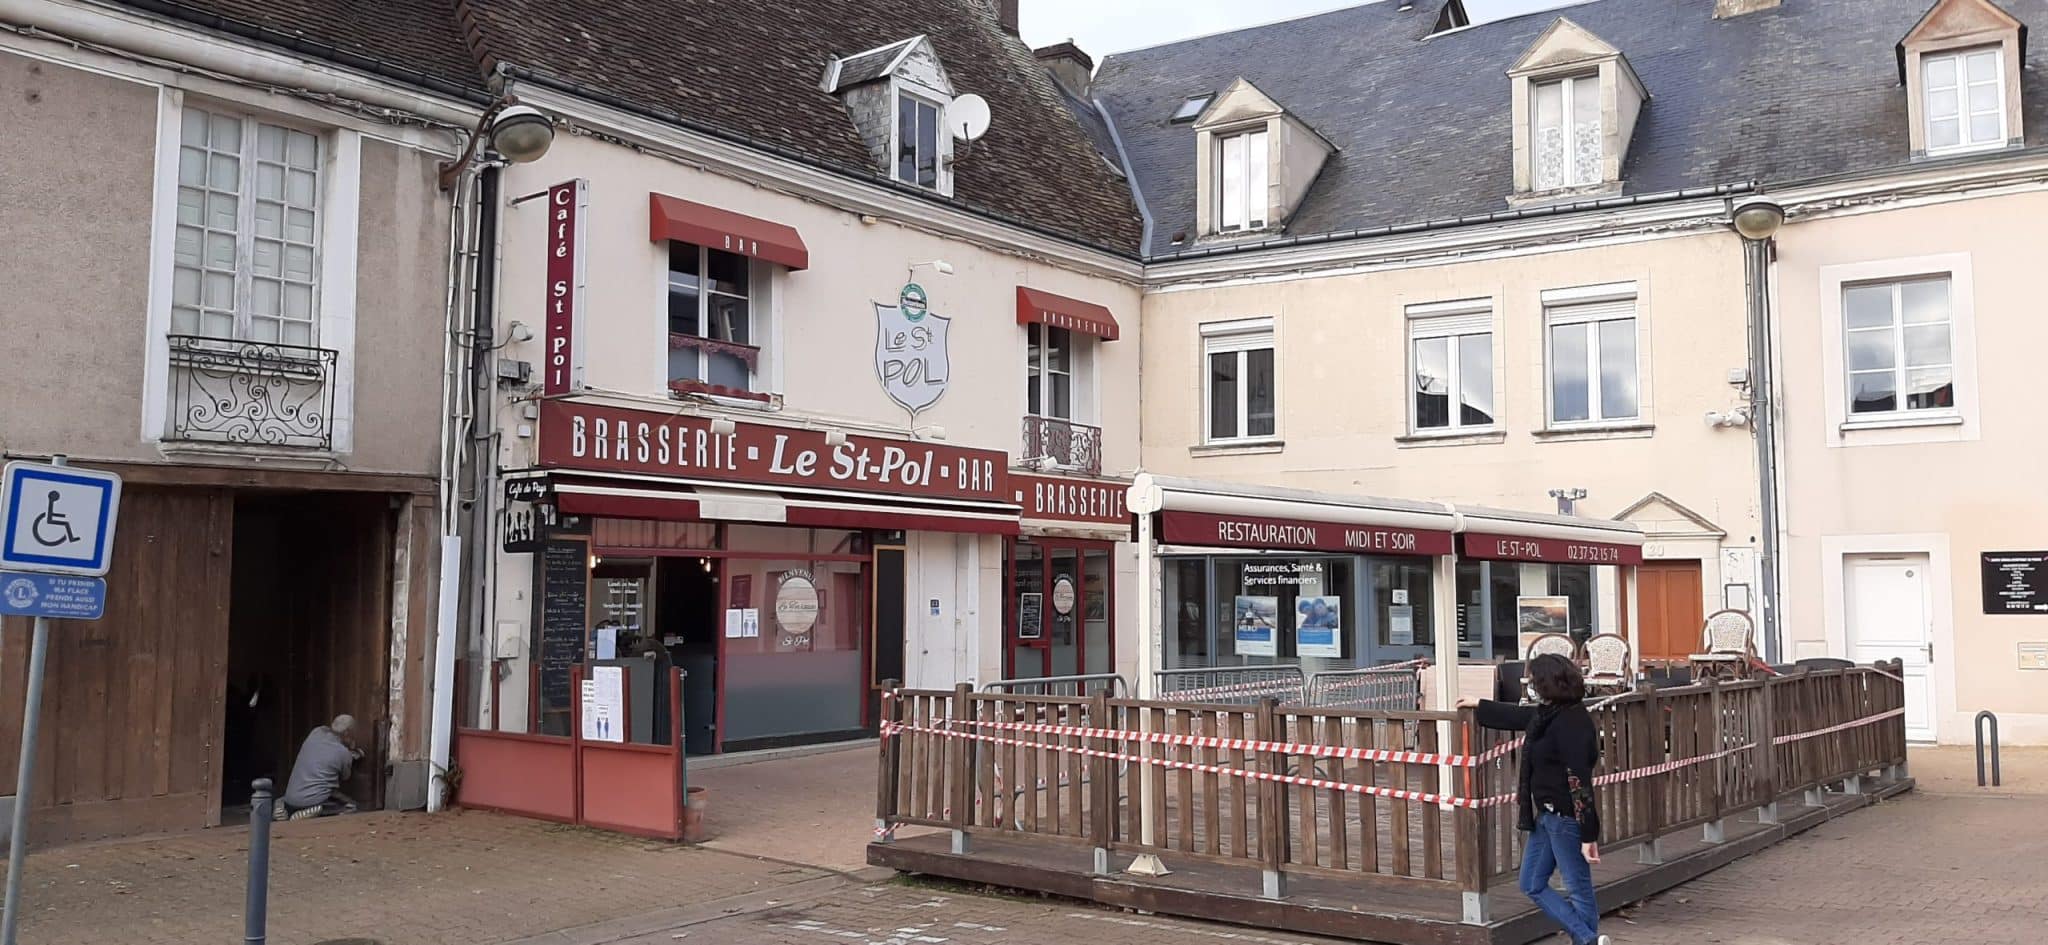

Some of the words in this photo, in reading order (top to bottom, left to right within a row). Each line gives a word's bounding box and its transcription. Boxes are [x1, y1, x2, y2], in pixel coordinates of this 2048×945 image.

[555, 188, 570, 258] Café
[725, 234, 758, 257] BAR
[884, 327, 907, 352] Le
[911, 326, 934, 351] St
[883, 357, 946, 390] POL
[571, 415, 737, 471] BRASSERIE
[769, 433, 818, 477] Le
[830, 440, 934, 487] St-Pol
[958, 456, 994, 493] BAR
[1035, 482, 1124, 518] BRASSERIE
[1218, 521, 1316, 545] RESTAURATION
[1345, 530, 1371, 548] MIDI
[1375, 531, 1388, 548] ET
[1391, 533, 1416, 550] SOIR
[1497, 540, 1507, 555] LE
[1567, 545, 1578, 559] 02
[1579, 545, 1588, 560] 37
[1589, 546, 1599, 561] 52
[1600, 547, 1608, 561] 15
[1609, 547, 1619, 561] 74
[1244, 564, 1290, 573] Assurances,
[1291, 563, 1315, 573] Santé
[1315, 563, 1323, 572] &
[1244, 575, 1277, 586] Services
[1278, 575, 1318, 585] financiers
